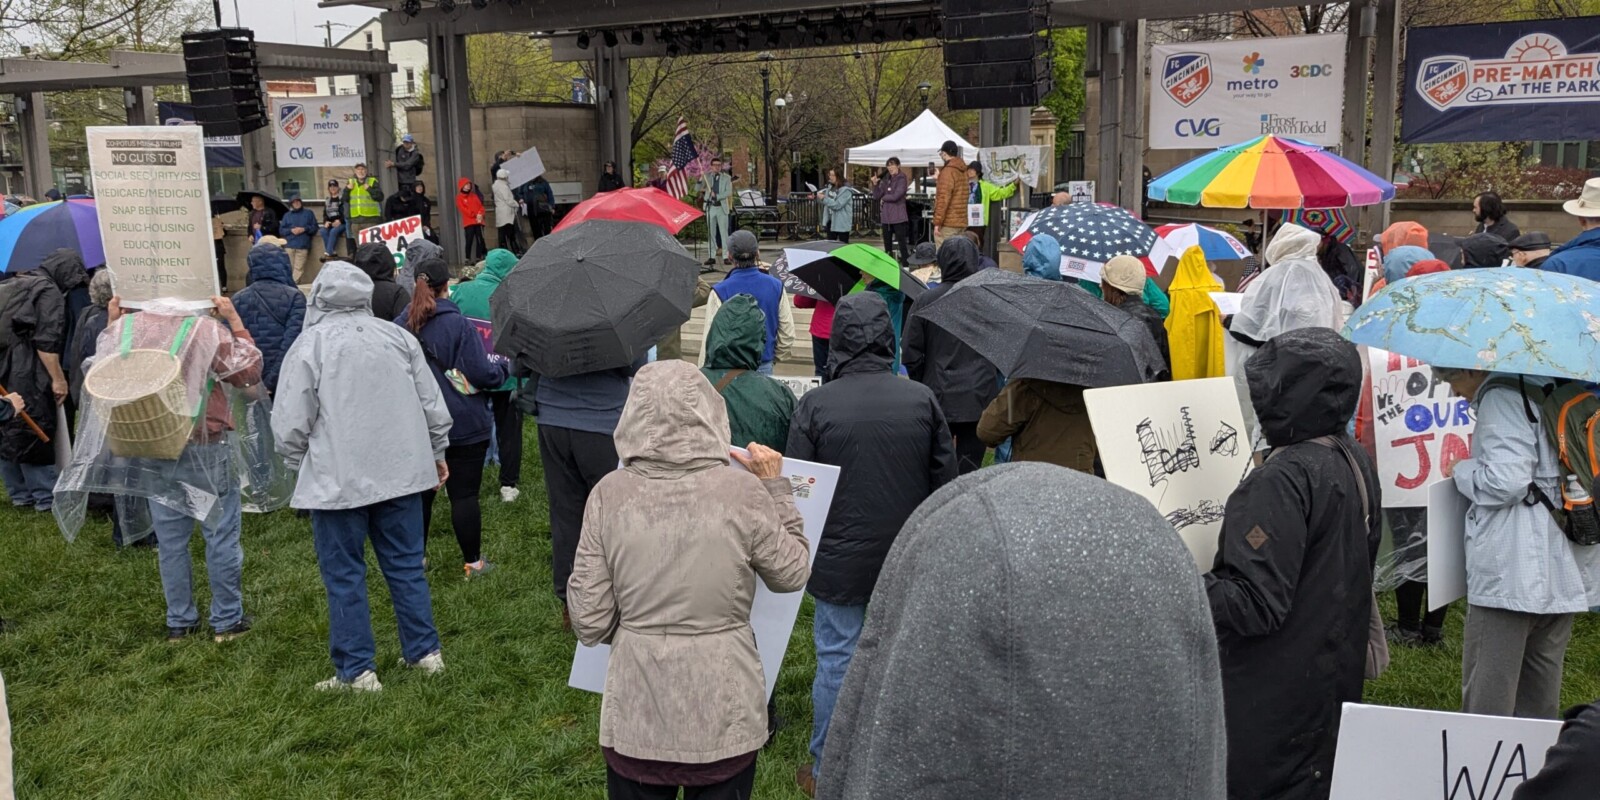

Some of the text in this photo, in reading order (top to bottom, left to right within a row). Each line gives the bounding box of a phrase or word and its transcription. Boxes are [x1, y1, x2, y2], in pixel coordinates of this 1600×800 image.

[1170, 59, 1180, 69] FC
[1290, 63, 1332, 78] 3CDC
[1429, 65, 1438, 74] FC
[1165, 56, 1207, 89] CINCINNATI
[1424, 63, 1464, 90] CINCINNATI
[1473, 62, 1593, 83] PRE-MATCH
[1227, 77, 1279, 91] metro
[1497, 79, 1600, 96] AT THE PARK
[313, 121, 339, 130] metro
[1269, 113, 1297, 126] Frost
[1175, 118, 1221, 137] CVG
[1260, 121, 1327, 134] Brown Todd
[112, 153, 177, 164] NO CUTS TO:
[289, 147, 314, 159] CVG
[95, 171, 128, 180] SOCIAL
[97, 188, 202, 198] MEDICARE/MEDICAID
[112, 206, 188, 215] SNAP BENEFITS
[109, 223, 195, 233] PUBLIC HOUSING
[360, 216, 421, 246] TRUMP
[123, 240, 182, 250] EDUCATION
[120, 257, 191, 267] ENVIRONMENT
[1377, 393, 1393, 410] WE
[1376, 403, 1405, 426] THE
[1404, 399, 1470, 433] OUR
